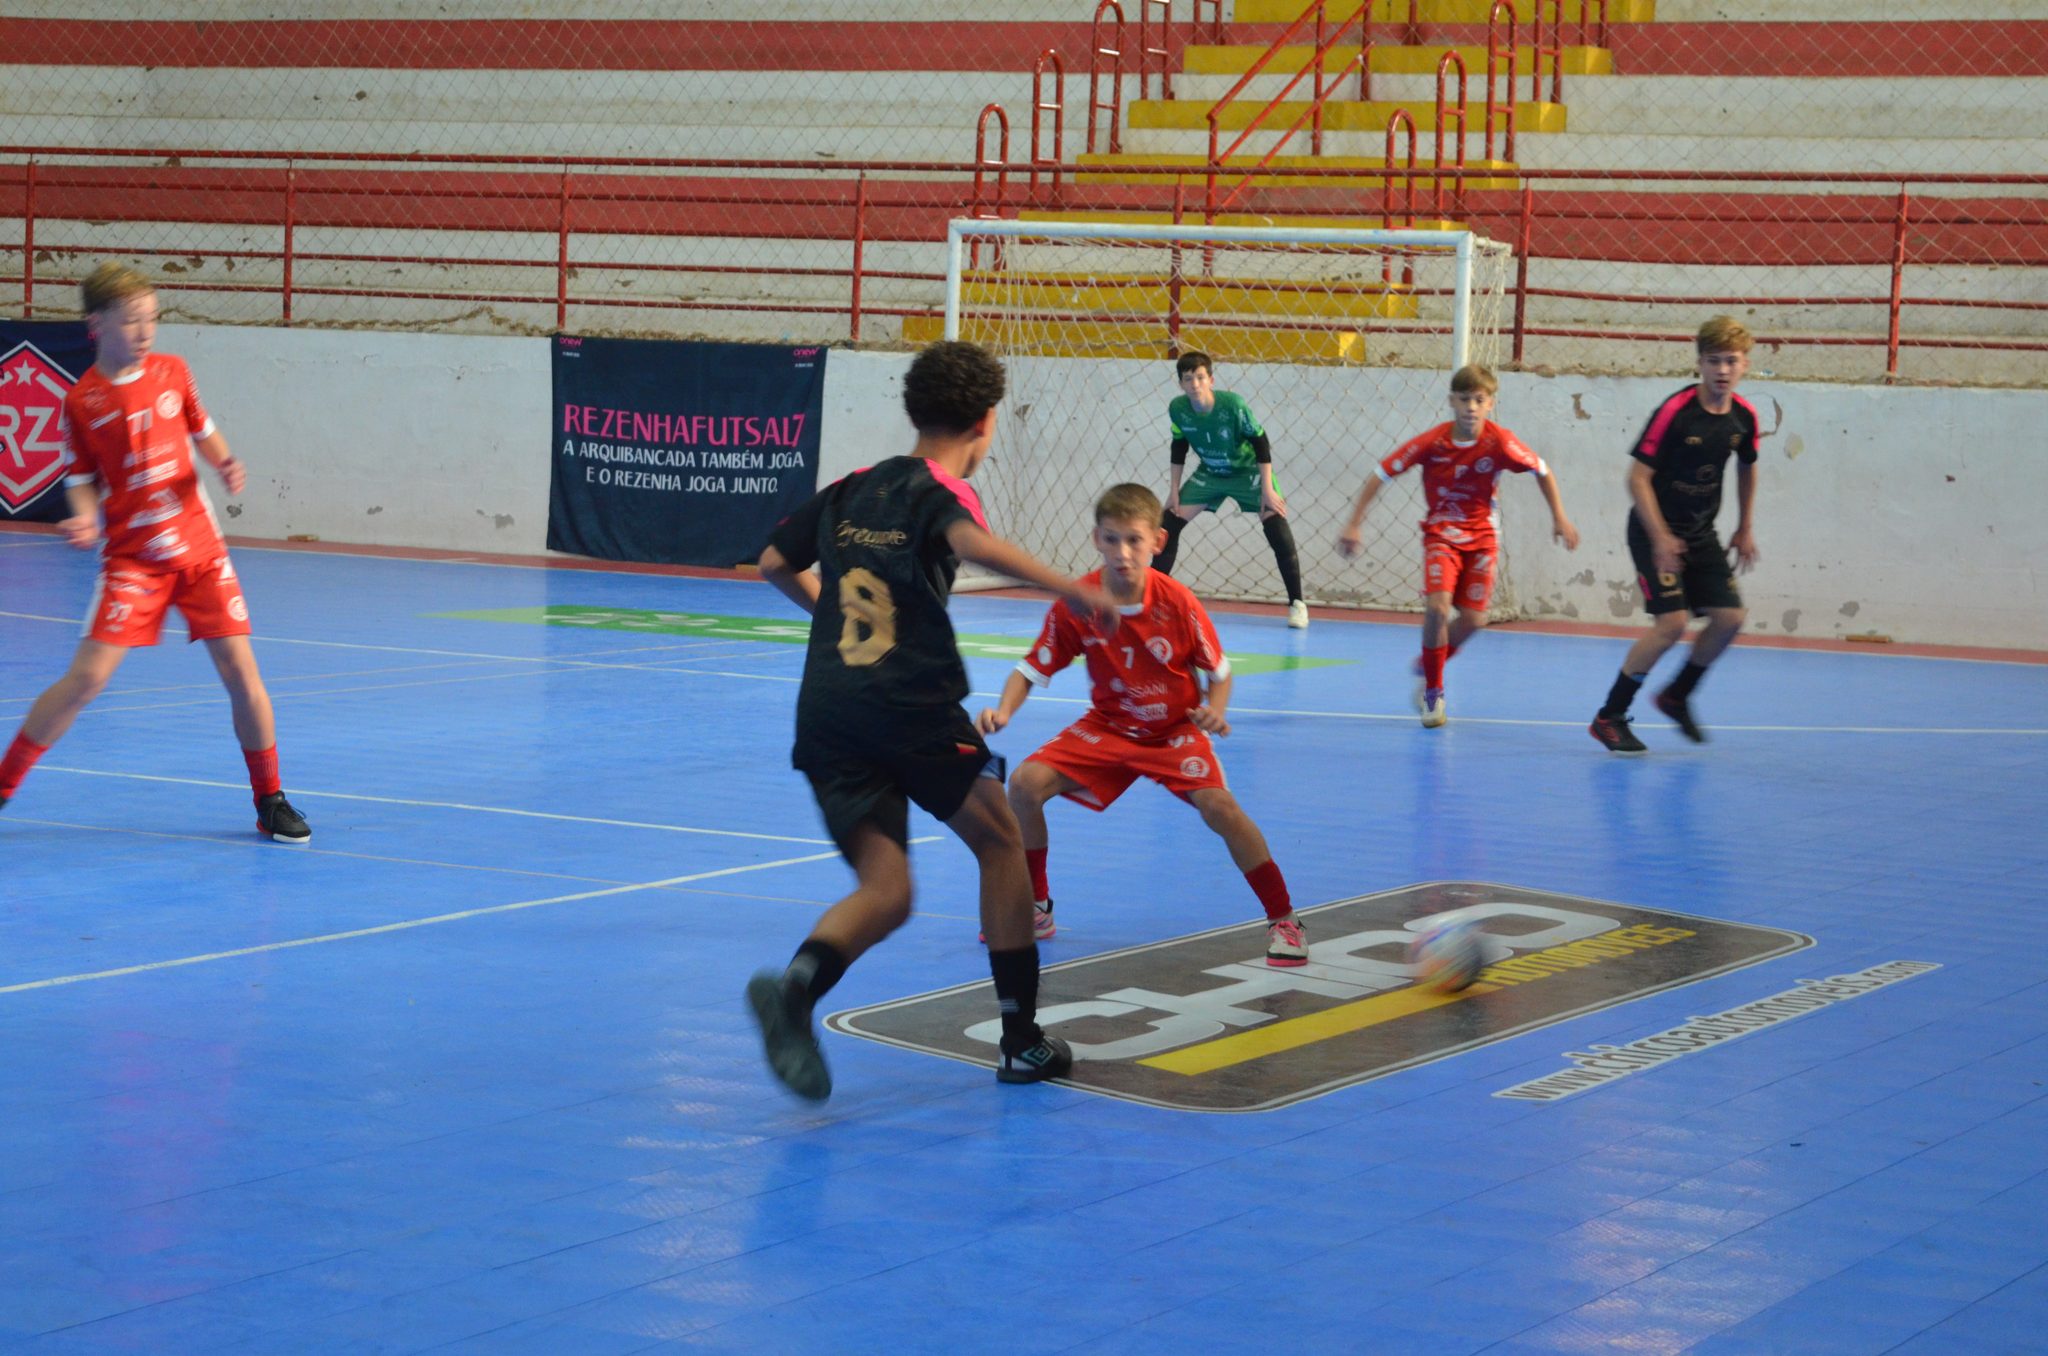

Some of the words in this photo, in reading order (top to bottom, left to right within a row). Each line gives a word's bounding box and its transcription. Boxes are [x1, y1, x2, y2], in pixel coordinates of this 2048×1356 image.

[563, 439, 574, 456] A
[579, 441, 696, 468] ARQUIBANCADA
[700, 449, 764, 469] TAMBÉM
[767, 451, 805, 469] JOGA
[586, 466, 595, 483] E
[599, 468, 611, 485] O
[614, 469, 682, 491] REZENHA
[685, 475, 726, 493] JOGA
[730, 476, 778, 494] JUNTO.
